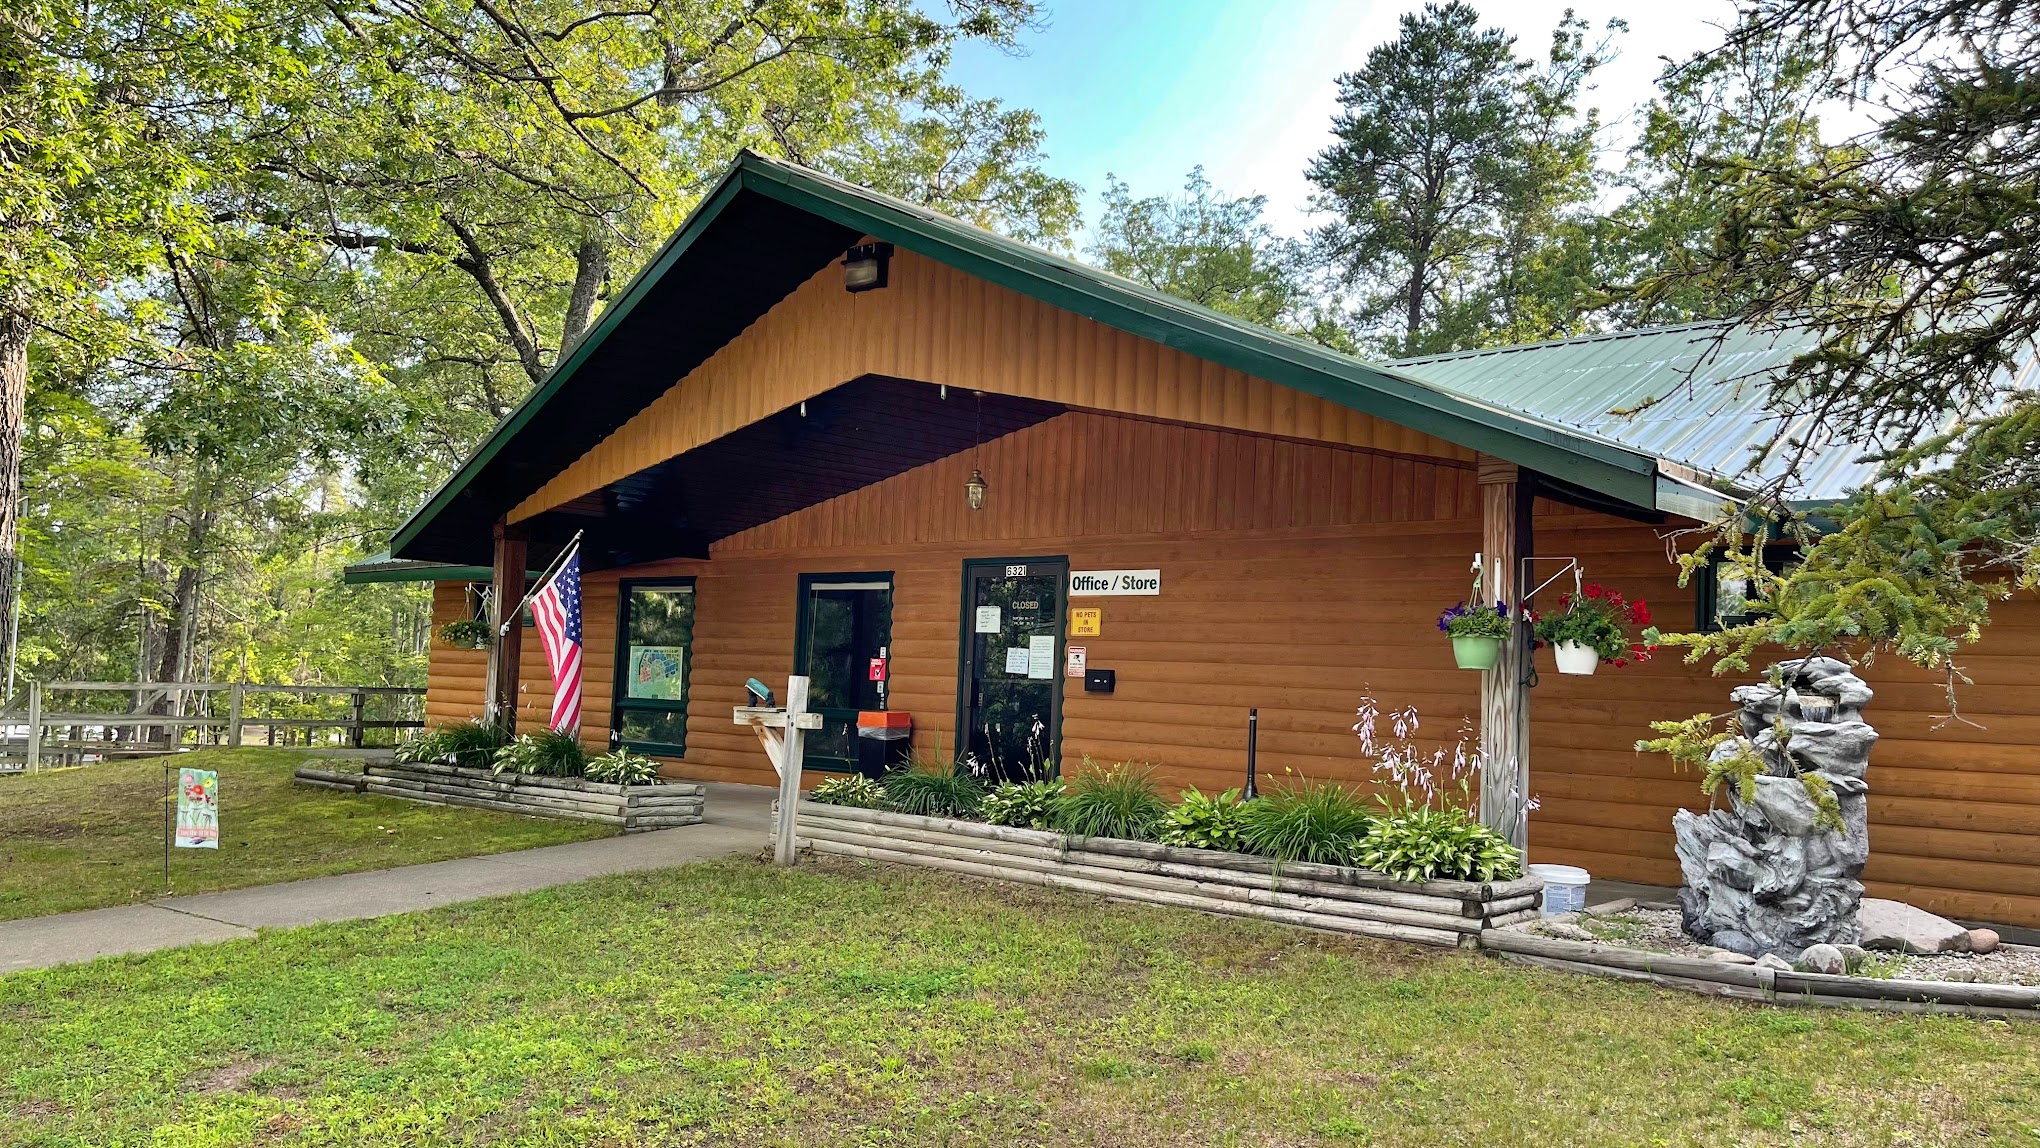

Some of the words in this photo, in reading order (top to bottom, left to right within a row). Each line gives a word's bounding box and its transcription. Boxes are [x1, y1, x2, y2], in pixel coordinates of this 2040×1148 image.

[1006, 566, 1026, 576] 6321
[1072, 576, 1109, 591] Office
[1111, 575, 1119, 591] /
[1121, 575, 1157, 590] Store
[1012, 601, 1039, 610] CLOSED
